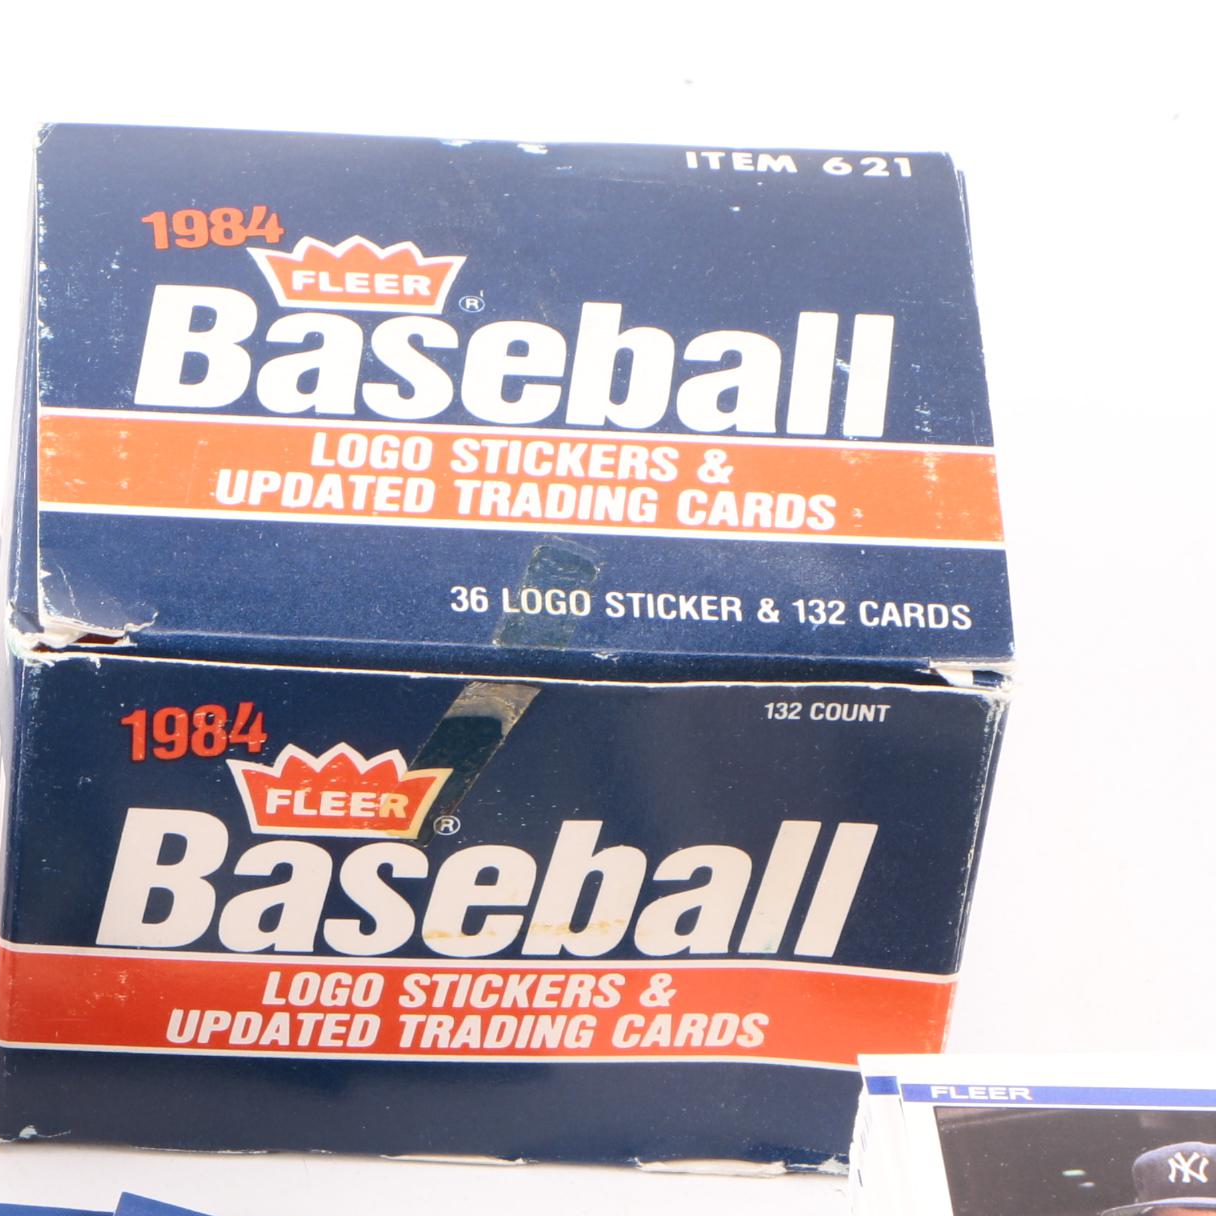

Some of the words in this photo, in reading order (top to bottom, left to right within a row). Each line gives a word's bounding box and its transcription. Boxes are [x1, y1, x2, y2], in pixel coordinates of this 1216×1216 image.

[686, 151, 798, 173] ITEM
[822, 157, 912, 177] 621
[141, 205, 284, 249] 1984
[291, 270, 432, 296] FLEER
[134, 284, 894, 438] Baseball
[311, 432, 433, 471] LOGO
[450, 438, 679, 483] STICKERS
[697, 449, 733, 484] &
[215, 469, 436, 514] UPDATED
[453, 479, 658, 523] TRADING
[677, 489, 836, 531] CARDS
[450, 586, 489, 613] 36
[502, 588, 590, 616] LOGO
[605, 591, 742, 622] STICKER
[757, 598, 780, 624] &
[792, 599, 845, 625] 132
[859, 601, 972, 630] CARDS
[120, 702, 269, 761] 1984
[765, 703, 803, 720] 132
[809, 703, 891, 722] COUNT
[265, 789, 409, 818] FLEER
[96, 808, 878, 958] Baseball
[263, 971, 384, 1007] LOGO
[399, 973, 625, 1008] STICKERS
[640, 973, 677, 1007] &
[166, 1008, 381, 1049] UPDATED
[399, 1012, 595, 1049] TRADING
[611, 1012, 769, 1048] CARDS
[930, 1085, 1032, 1101] FLEER
